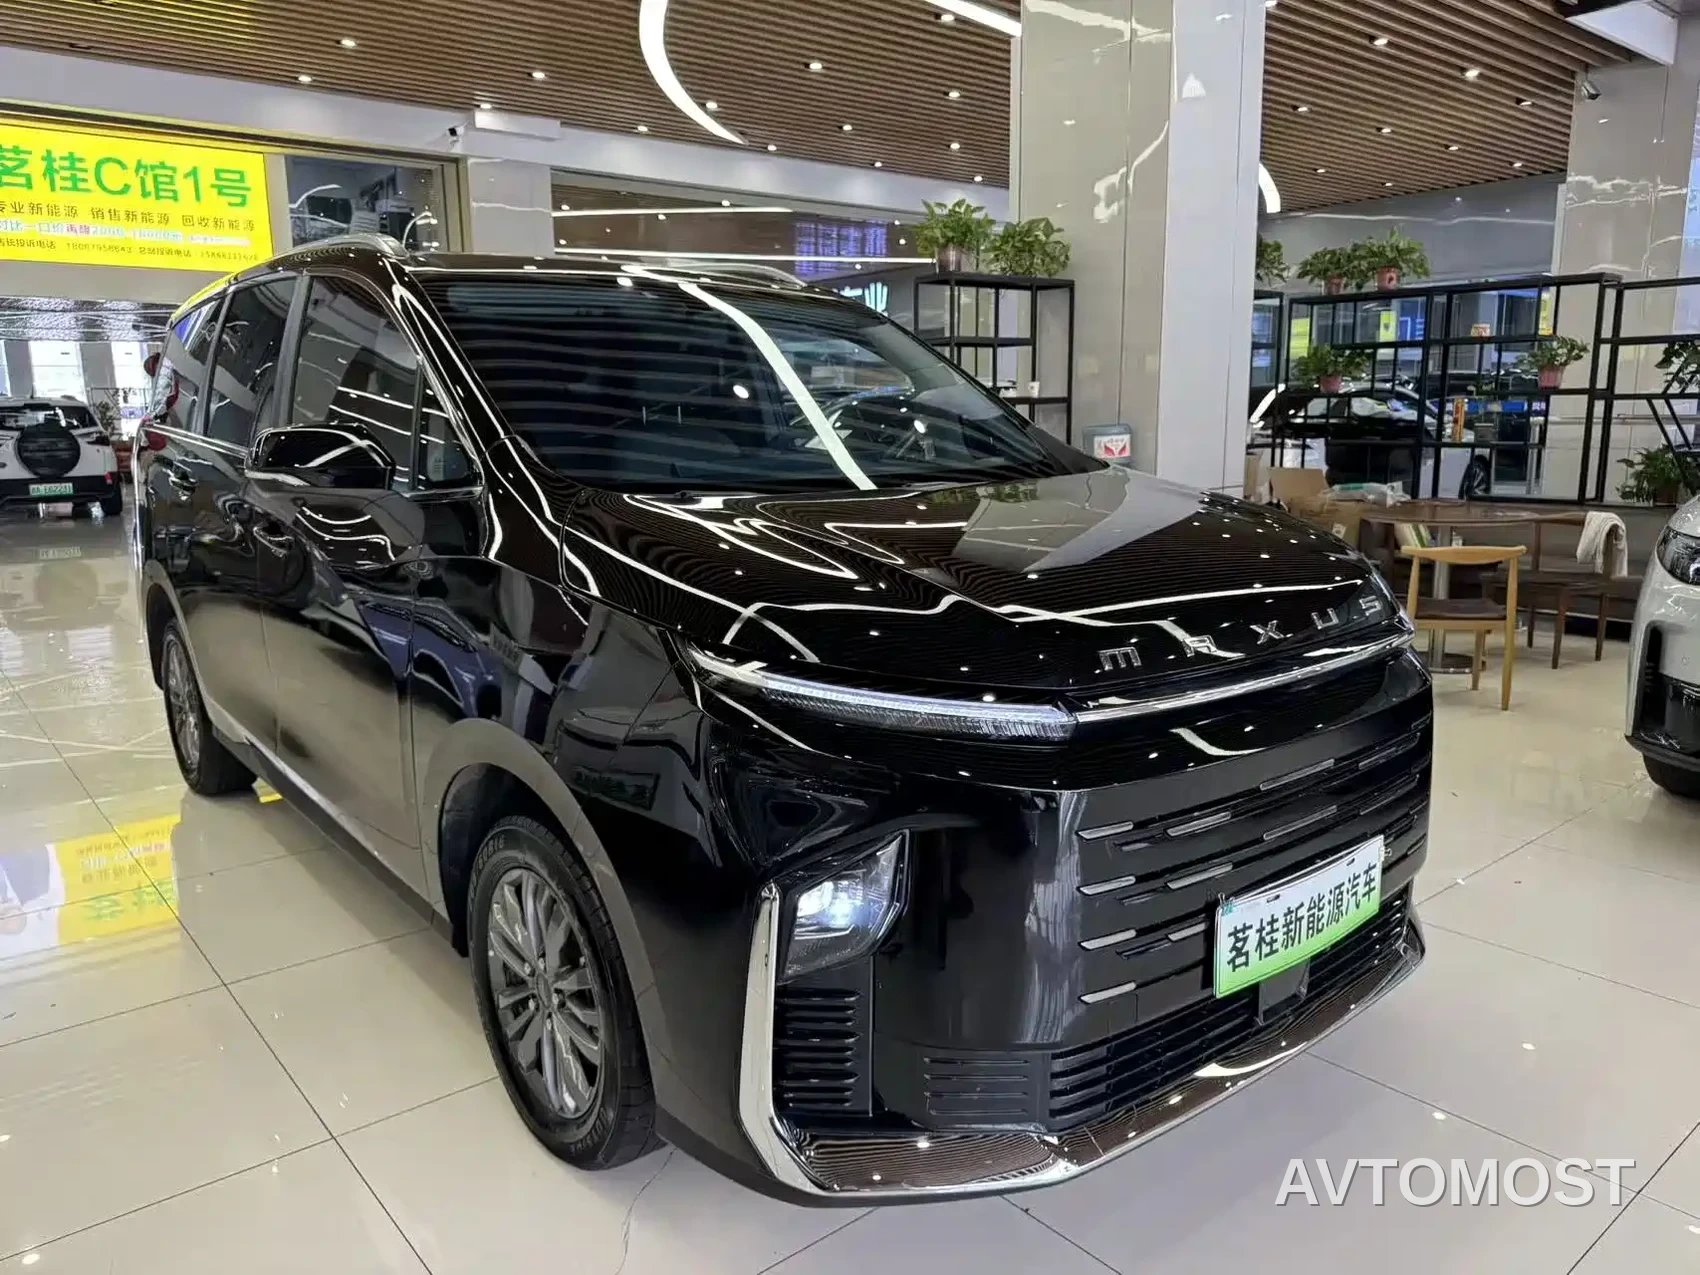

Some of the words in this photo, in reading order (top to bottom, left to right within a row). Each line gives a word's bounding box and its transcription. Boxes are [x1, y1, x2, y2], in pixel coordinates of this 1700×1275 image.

[0, 144, 252, 208] 茗桂C馆1号
[91, 207, 170, 227] 销售新能源
[182, 215, 255, 232] 回收新能源
[1227, 862, 1377, 973] 茗桂新能源汽车
